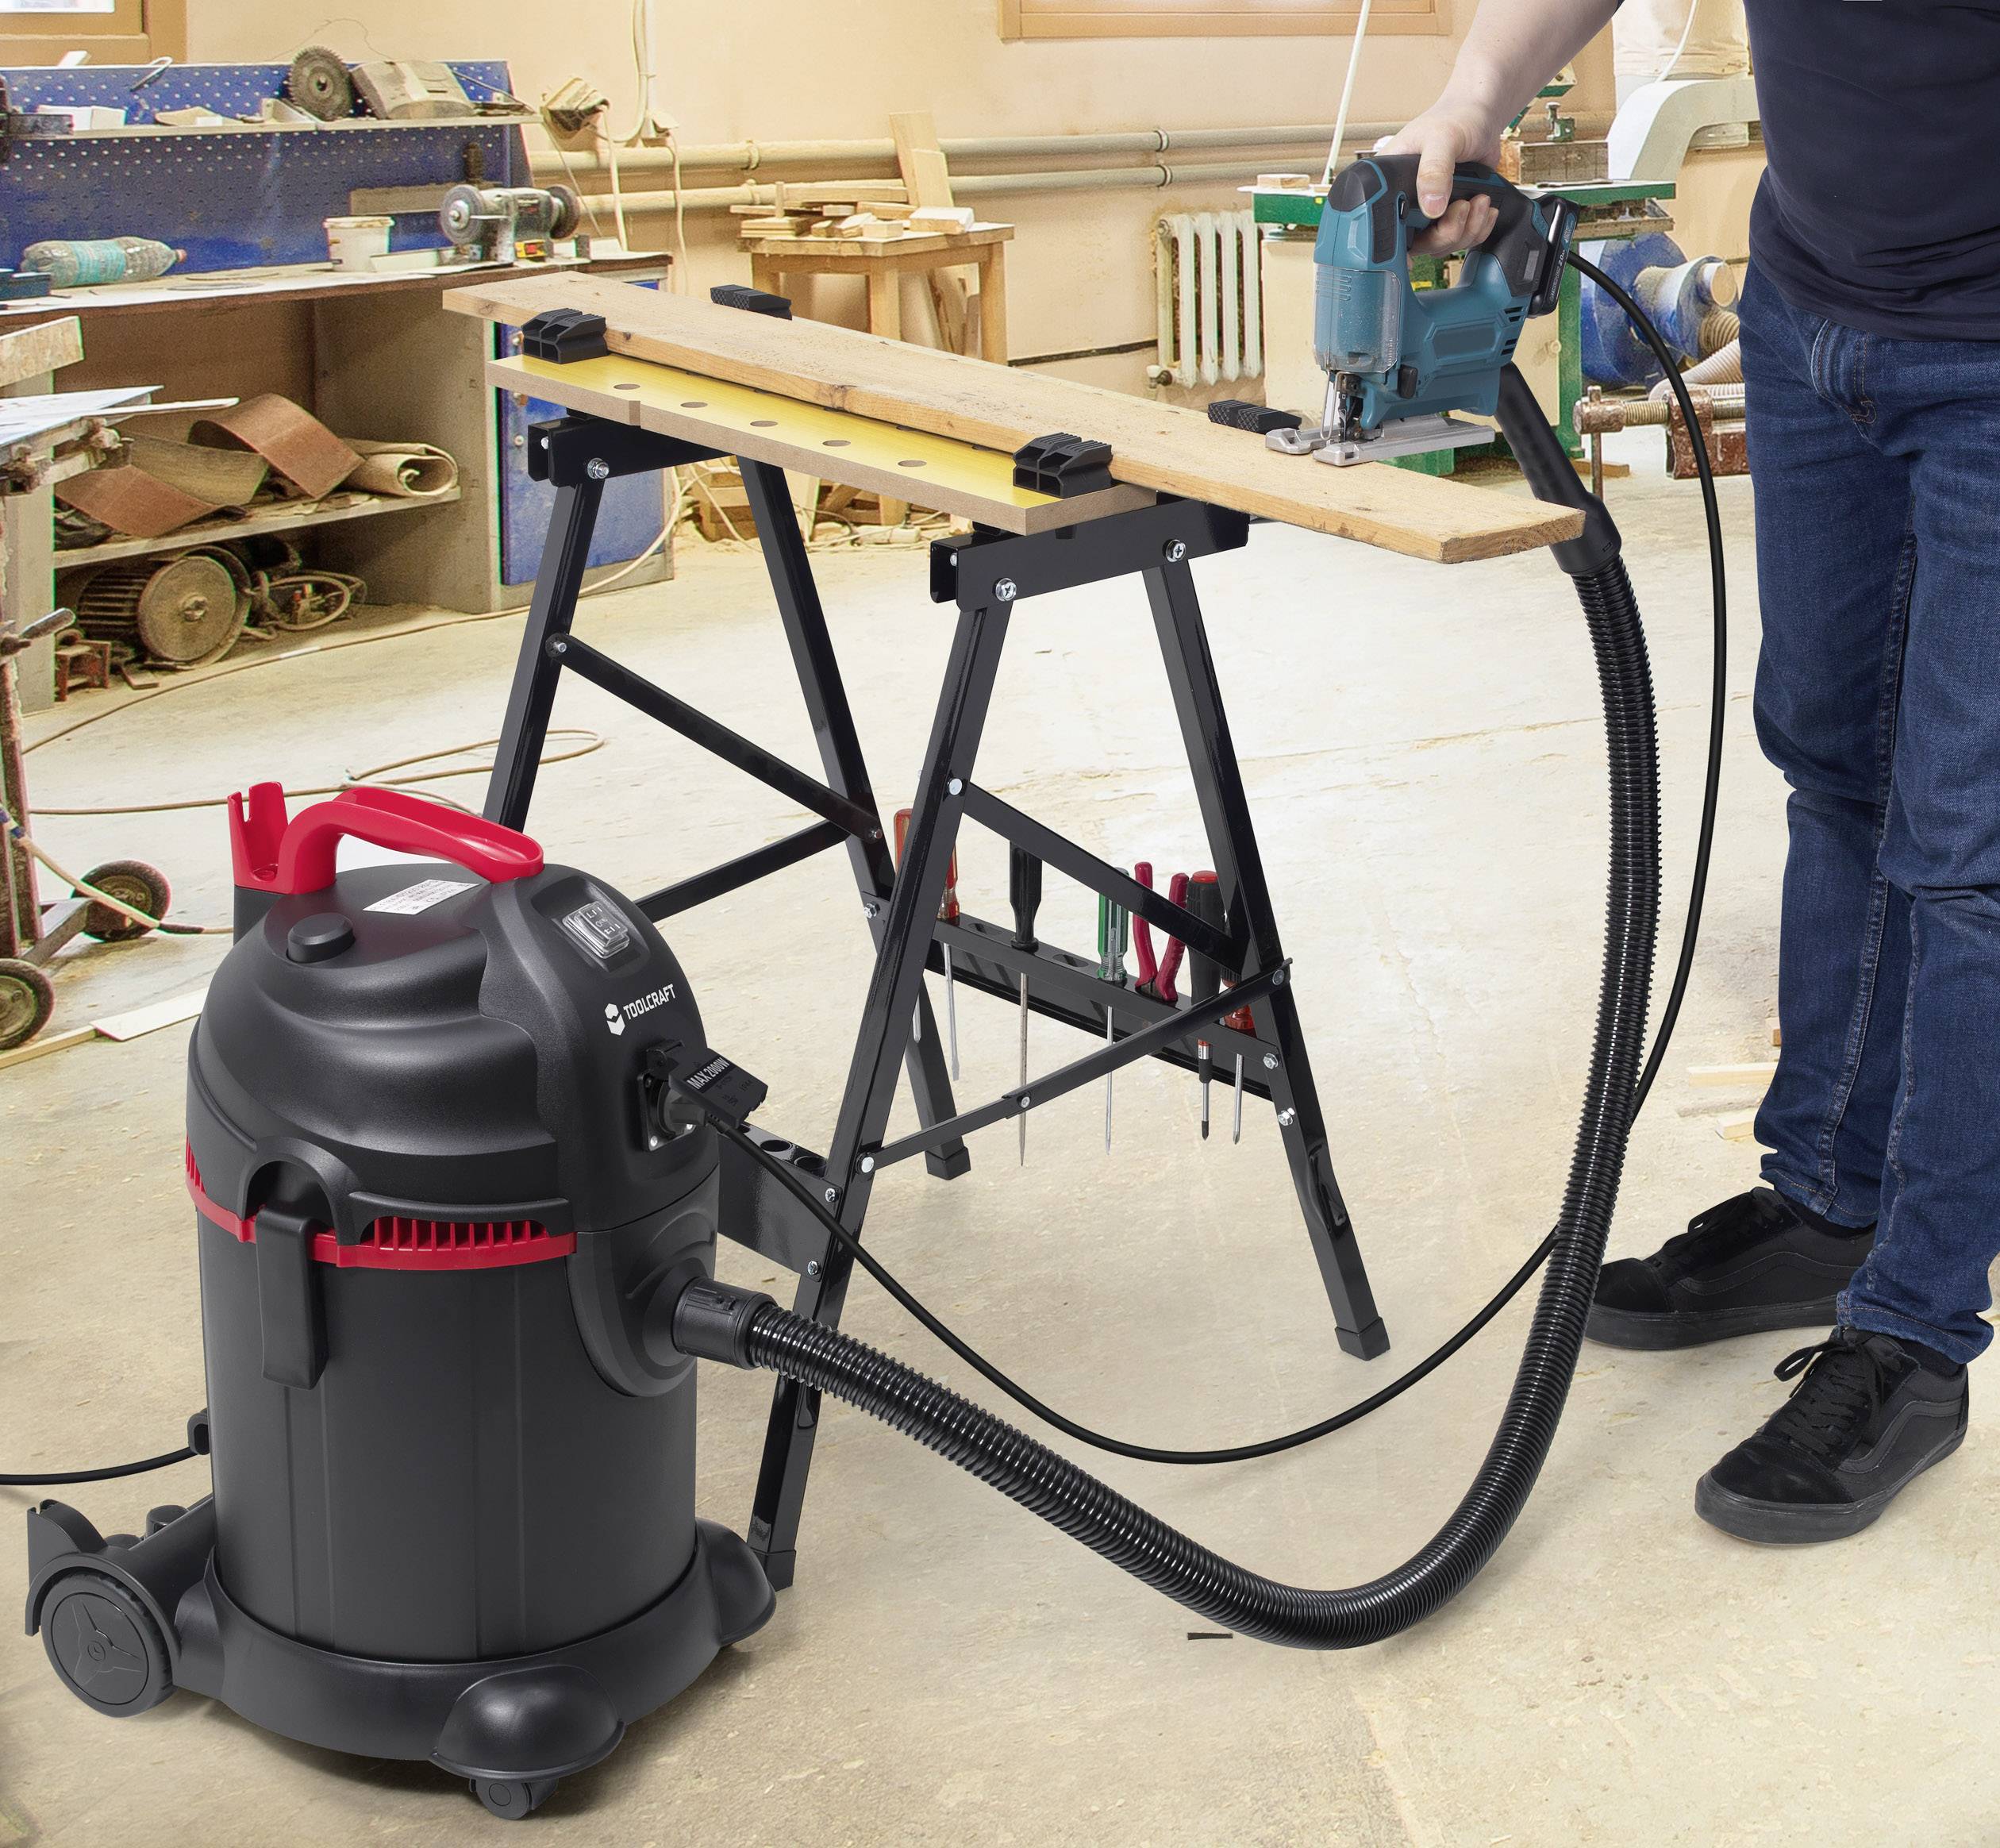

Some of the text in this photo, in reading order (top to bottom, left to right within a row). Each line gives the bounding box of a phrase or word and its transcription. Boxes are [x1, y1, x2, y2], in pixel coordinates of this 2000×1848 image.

[623, 984, 675, 1020] TOOLCRAFT
[687, 1071, 712, 1090] MAX
[703, 1057, 730, 1077] 2000W
